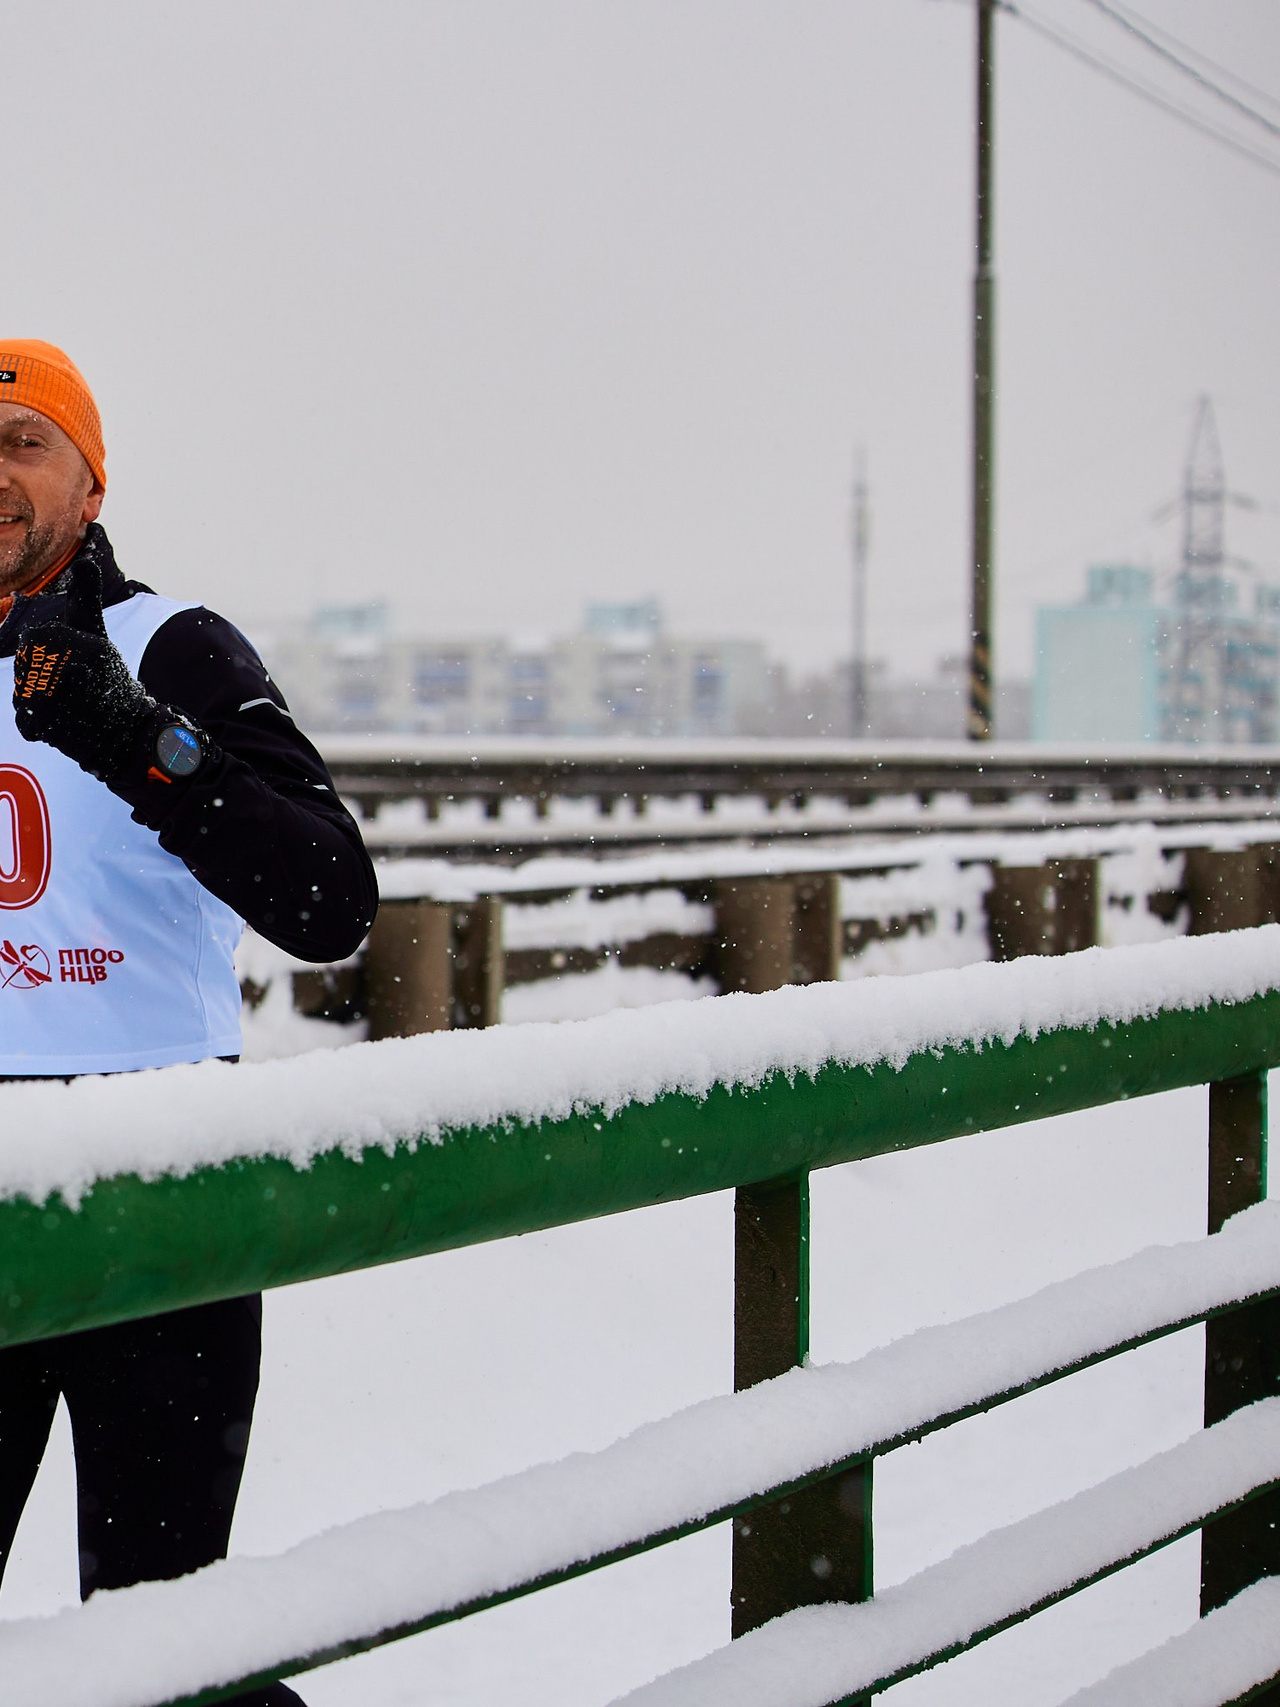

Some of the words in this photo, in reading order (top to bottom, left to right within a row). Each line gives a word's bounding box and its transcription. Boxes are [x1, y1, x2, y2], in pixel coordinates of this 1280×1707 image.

[22, 671, 39, 698] MAD
[31, 645, 46, 667] FOX
[35, 653, 60, 690] ULTRA
[58, 948, 125, 964] ППОО
[60, 965, 108, 985] НЦВ
